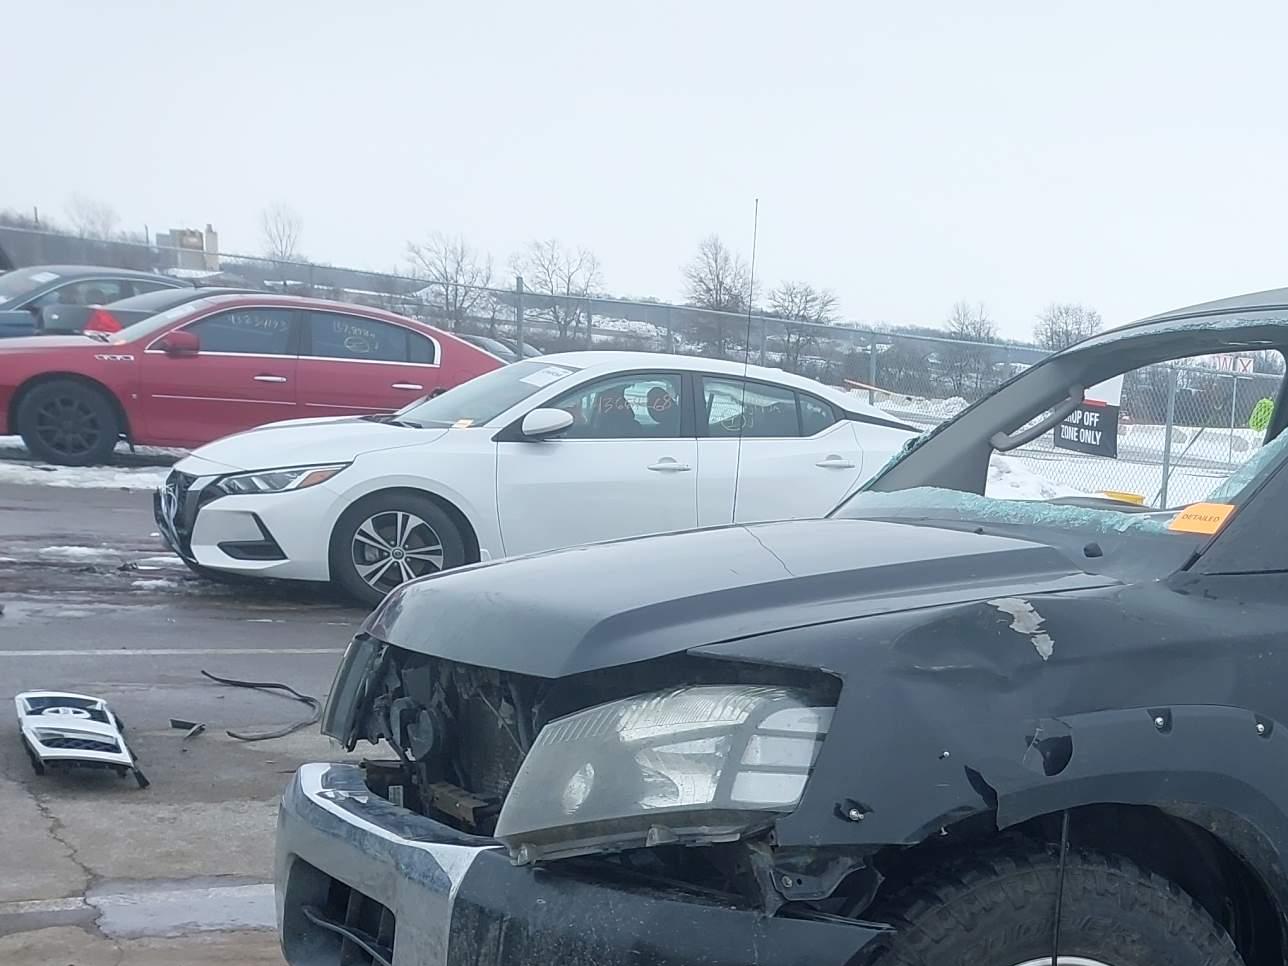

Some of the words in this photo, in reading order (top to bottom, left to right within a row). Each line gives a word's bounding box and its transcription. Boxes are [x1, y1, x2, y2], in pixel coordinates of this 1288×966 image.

[1083, 412, 1100, 427] OFF
[1060, 424, 1078, 441] ZONE
[1079, 429, 1102, 446] ONLY
